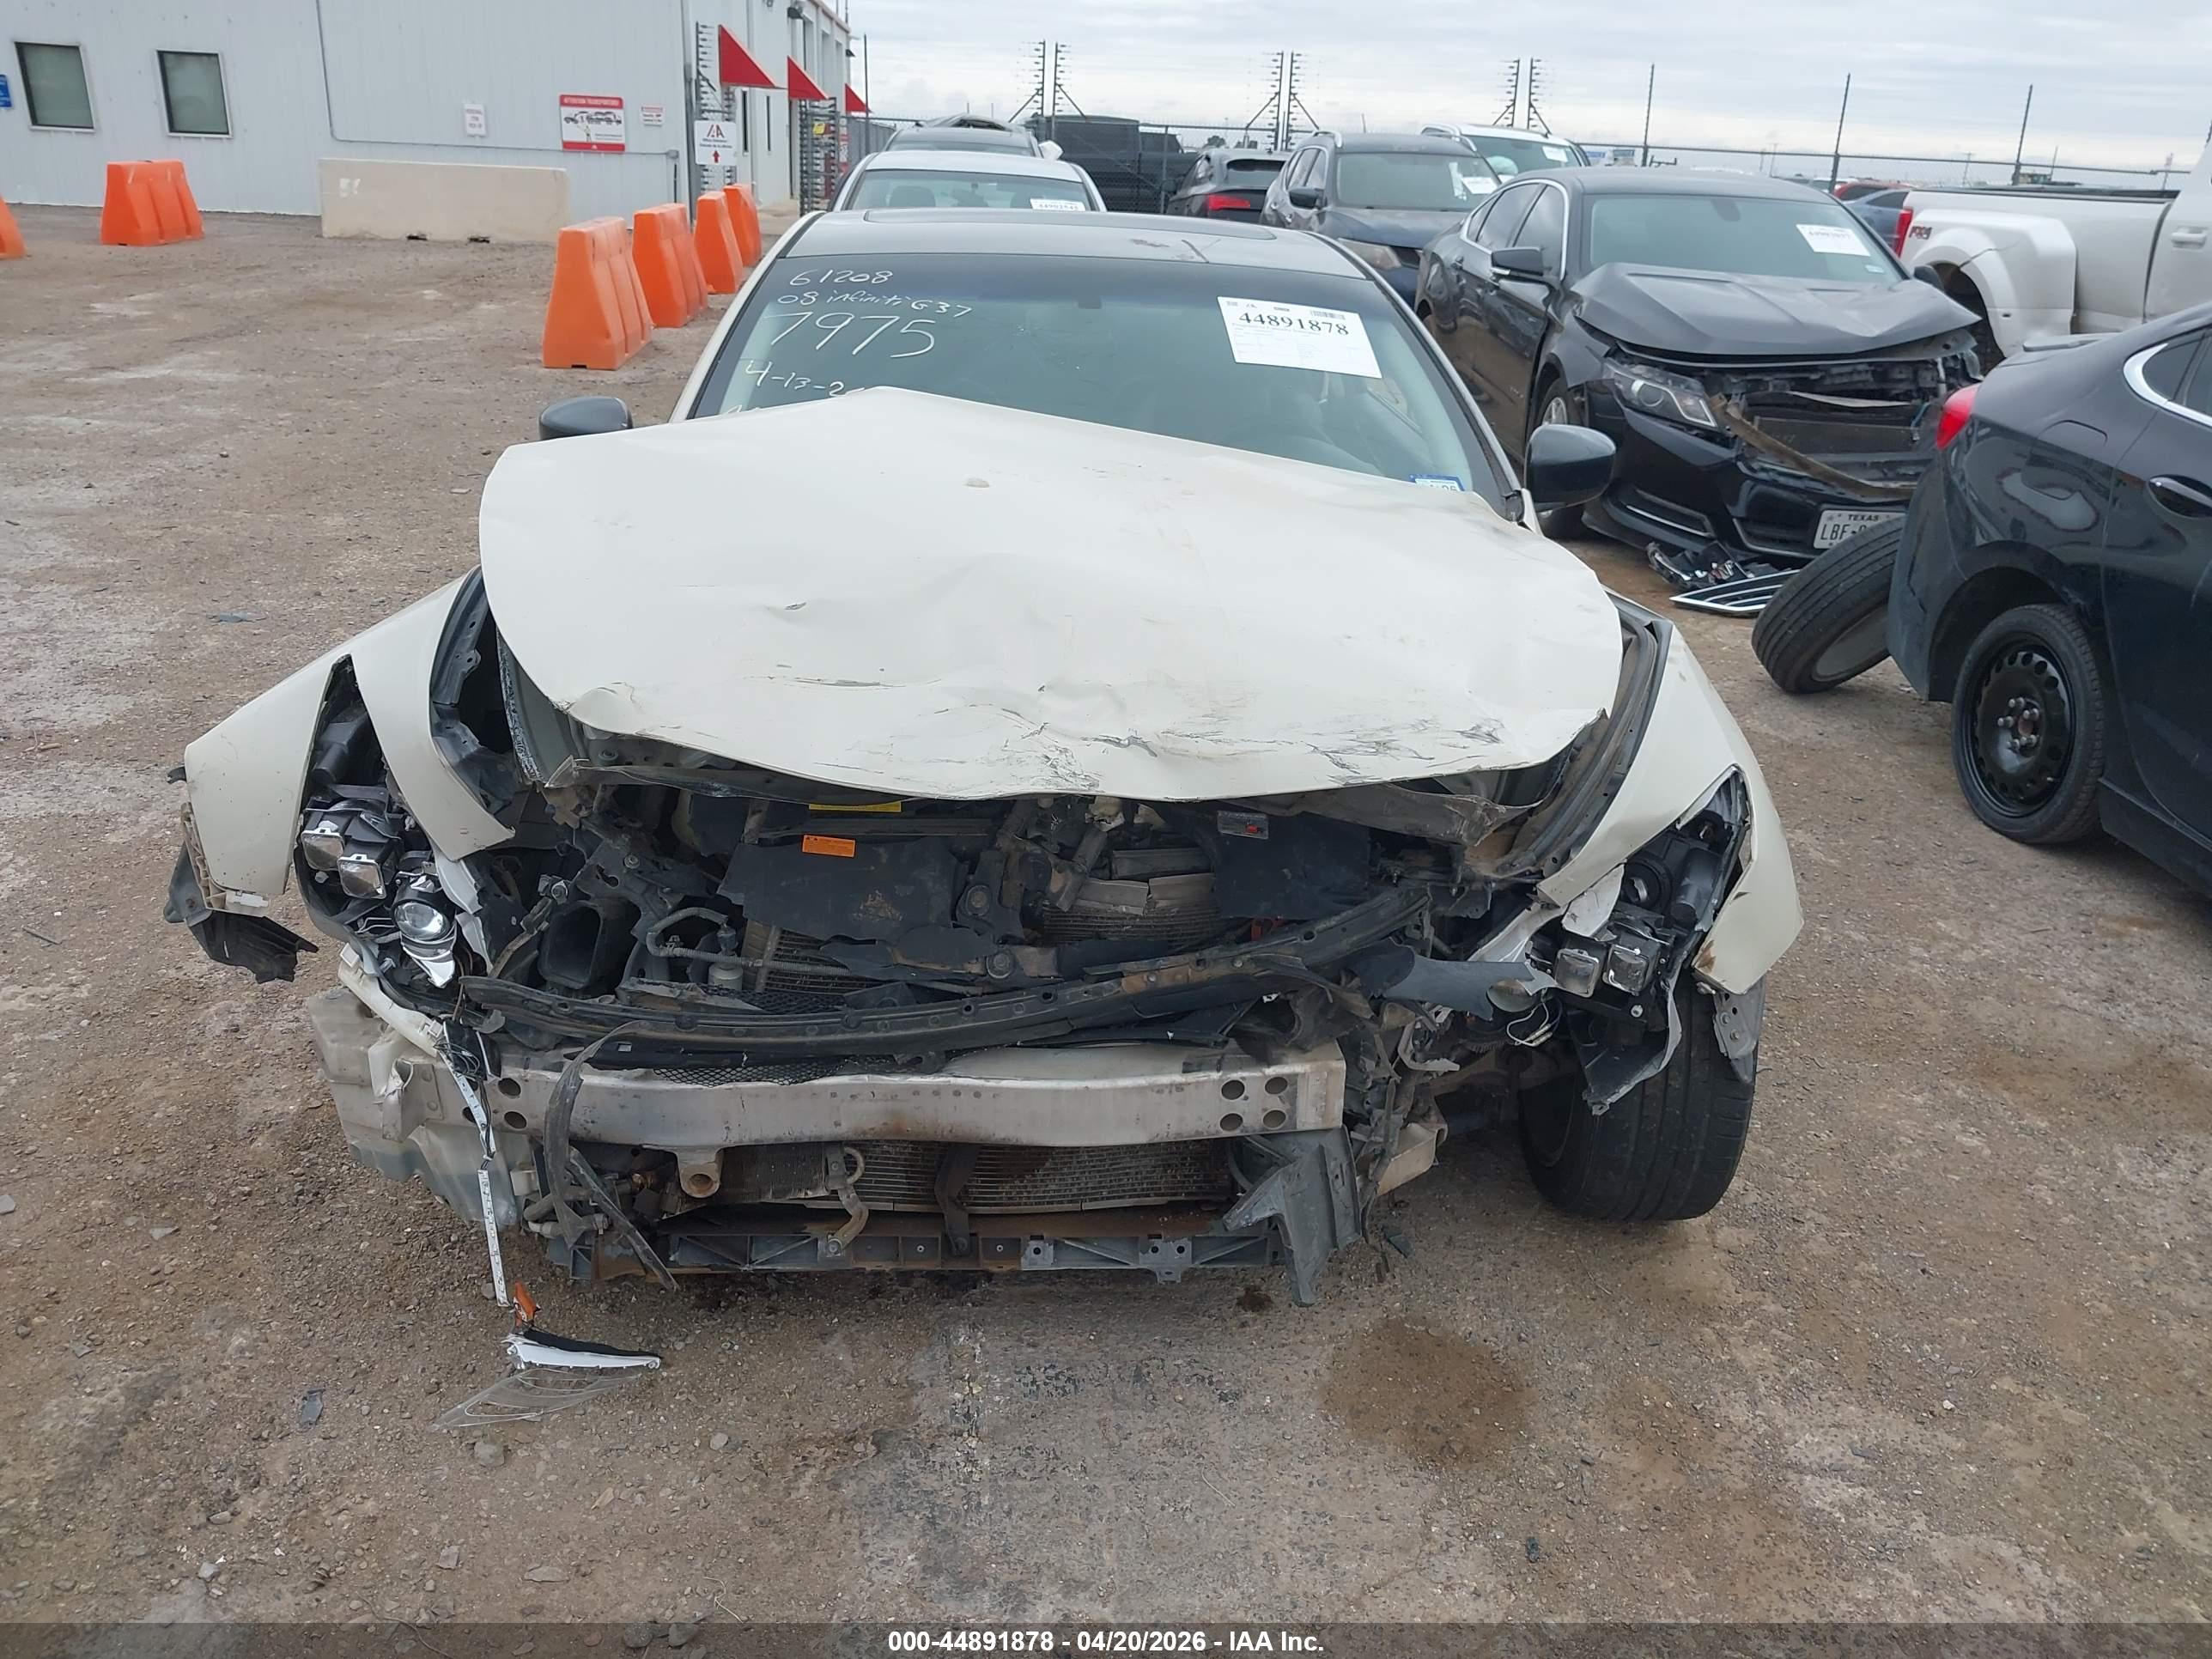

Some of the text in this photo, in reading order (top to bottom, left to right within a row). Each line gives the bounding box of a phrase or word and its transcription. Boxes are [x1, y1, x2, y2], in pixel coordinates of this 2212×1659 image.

[789, 269, 893, 286] 61208
[777, 290, 819, 306] 08
[910, 299, 973, 318] G37
[763, 311, 936, 359] 7975
[1238, 311, 1350, 336] 44891878
